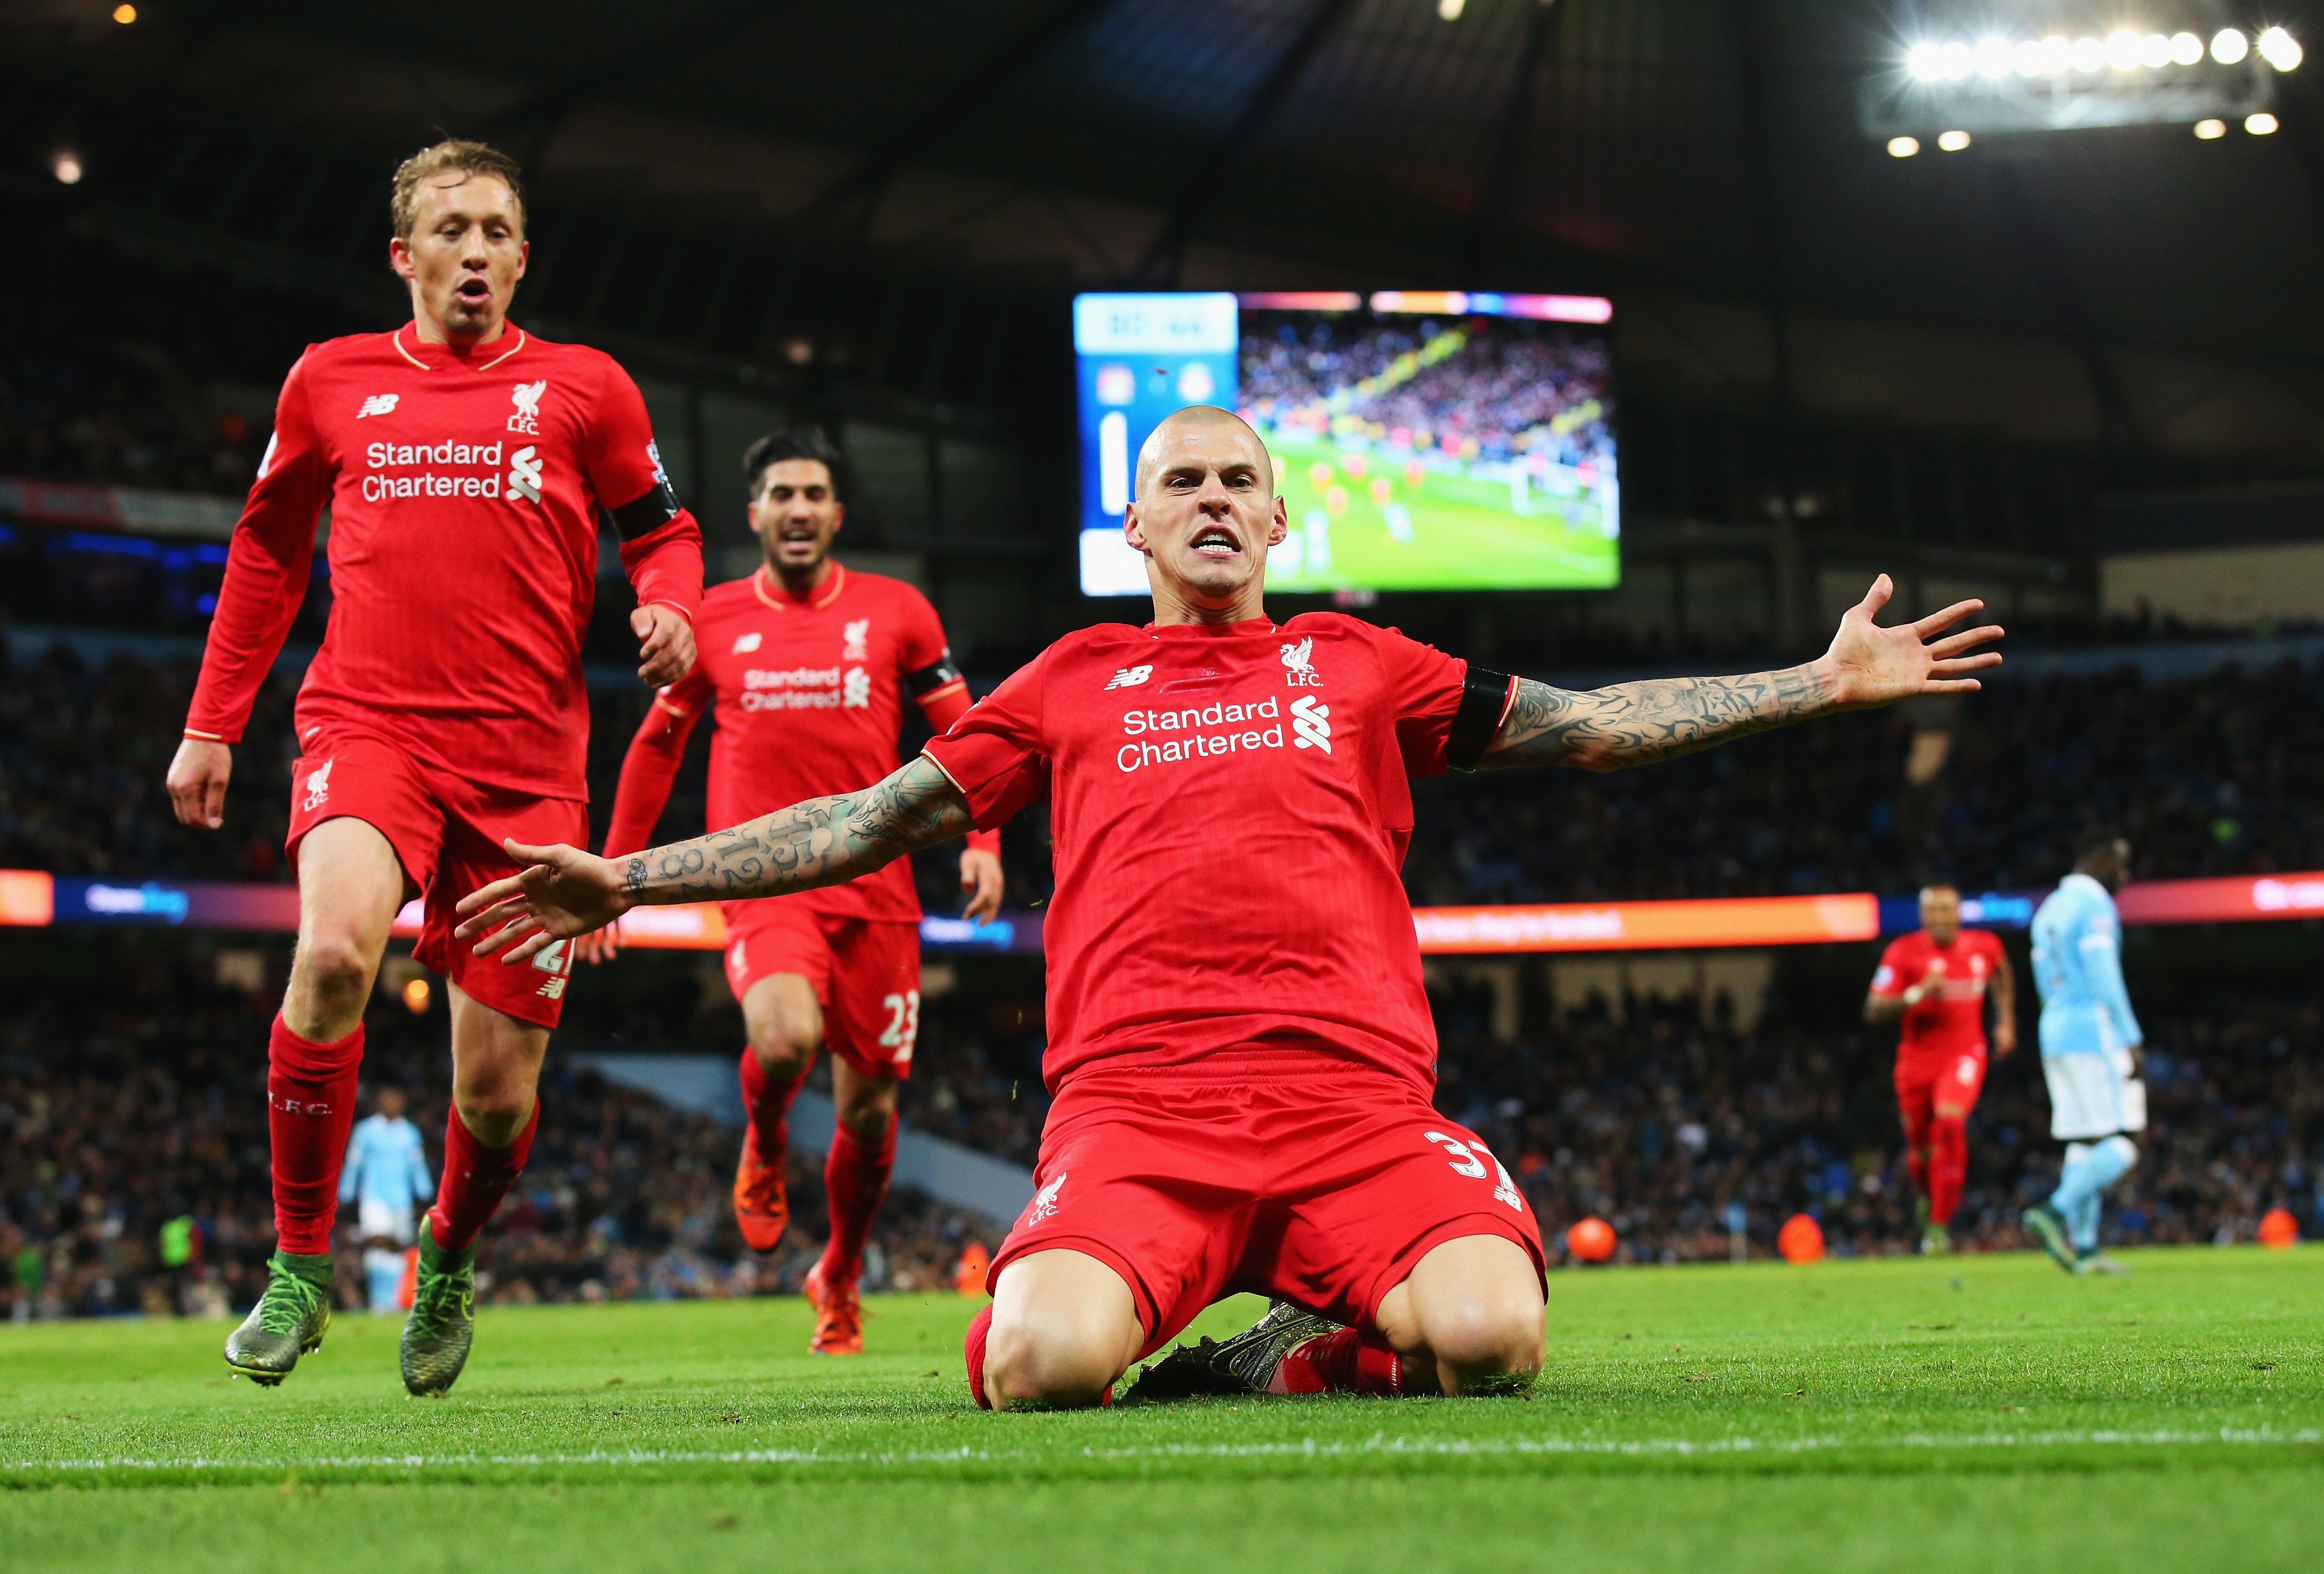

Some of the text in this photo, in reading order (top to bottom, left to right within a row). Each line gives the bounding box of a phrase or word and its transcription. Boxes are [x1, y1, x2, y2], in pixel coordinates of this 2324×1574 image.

[367, 439, 503, 468] Standard
[362, 472, 500, 503] Chartered
[1123, 696, 1279, 735] Standard
[1117, 724, 1284, 773] Chartered
[878, 989, 920, 1047] 23
[1424, 1131, 1517, 1194] 37
